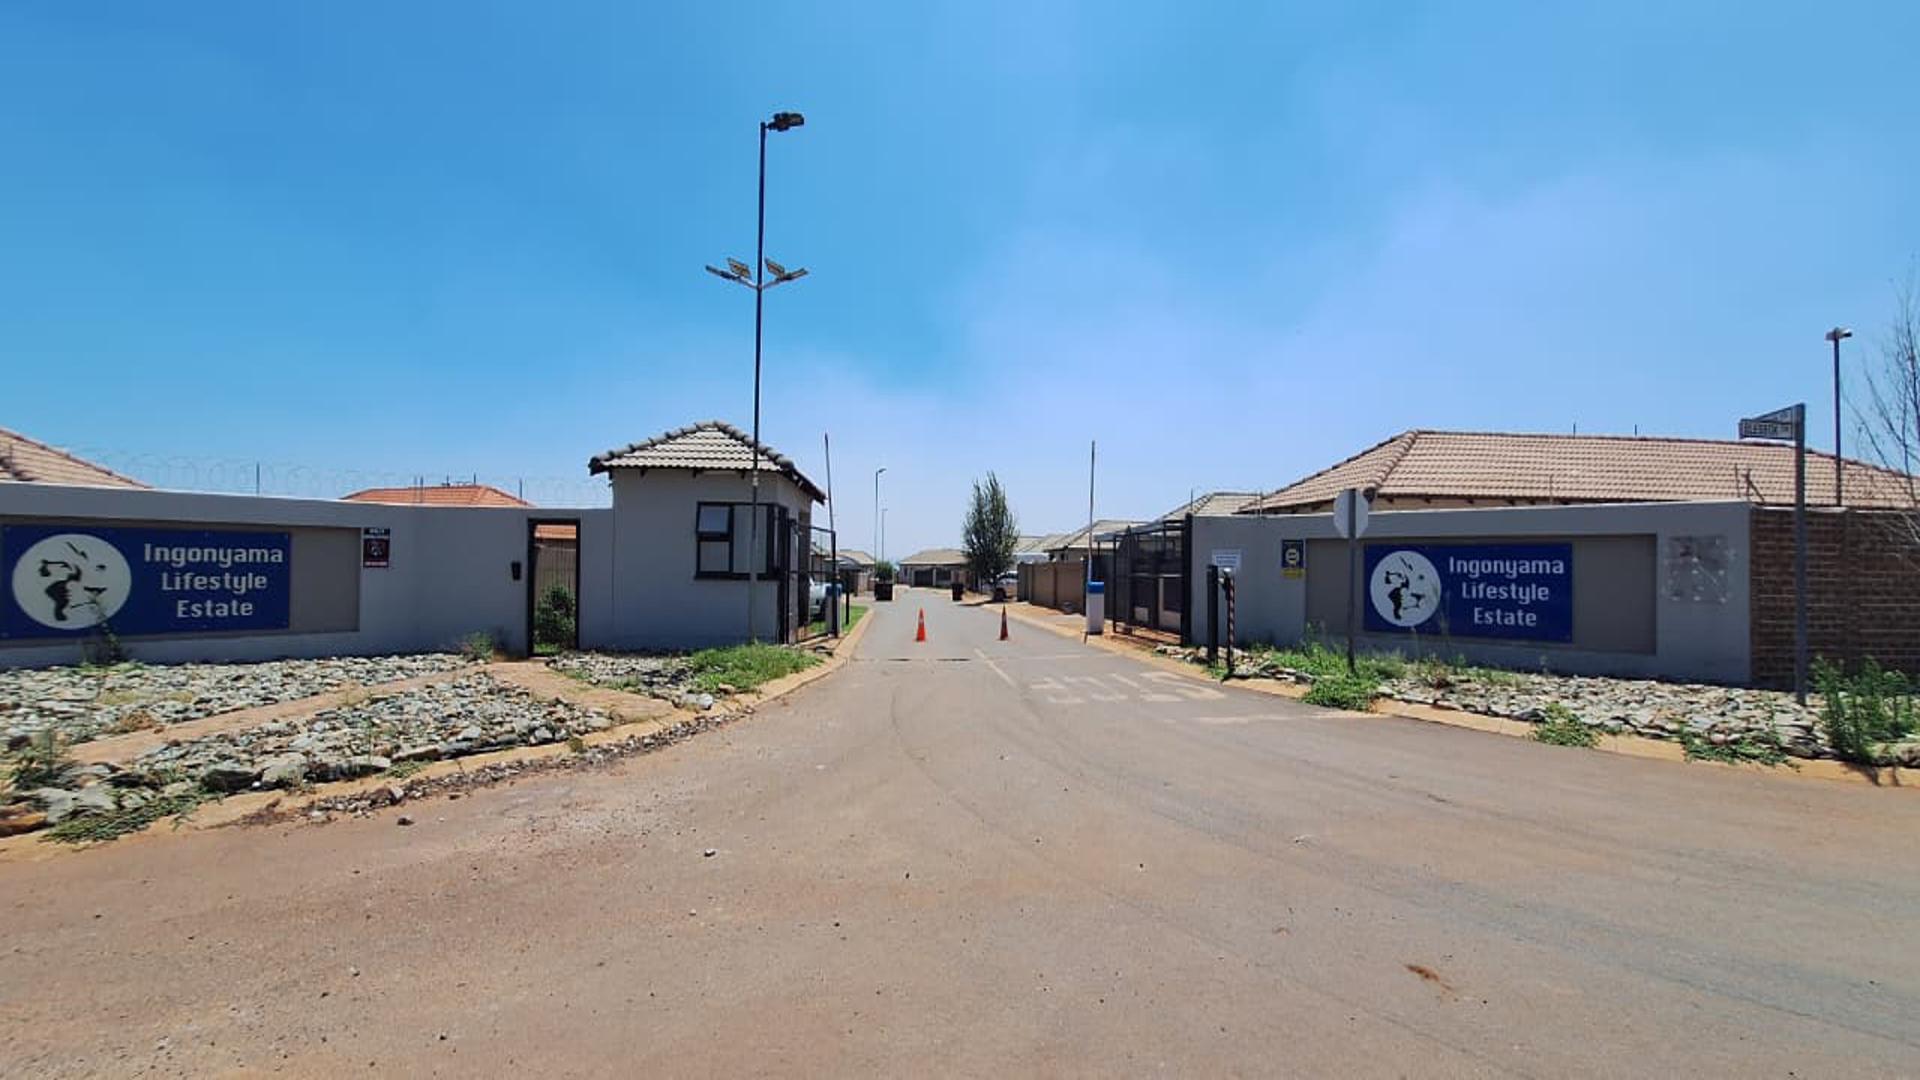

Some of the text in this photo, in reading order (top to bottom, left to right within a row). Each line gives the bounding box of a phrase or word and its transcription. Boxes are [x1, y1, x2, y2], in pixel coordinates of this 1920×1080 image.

[143, 543, 284, 569] Ingonyama
[1448, 556, 1565, 579] Ingonyama
[161, 571, 268, 595] Lifestyle
[1461, 581, 1550, 606] Lifestyle
[176, 599, 254, 619] Estate
[1473, 606, 1538, 627] Estate
